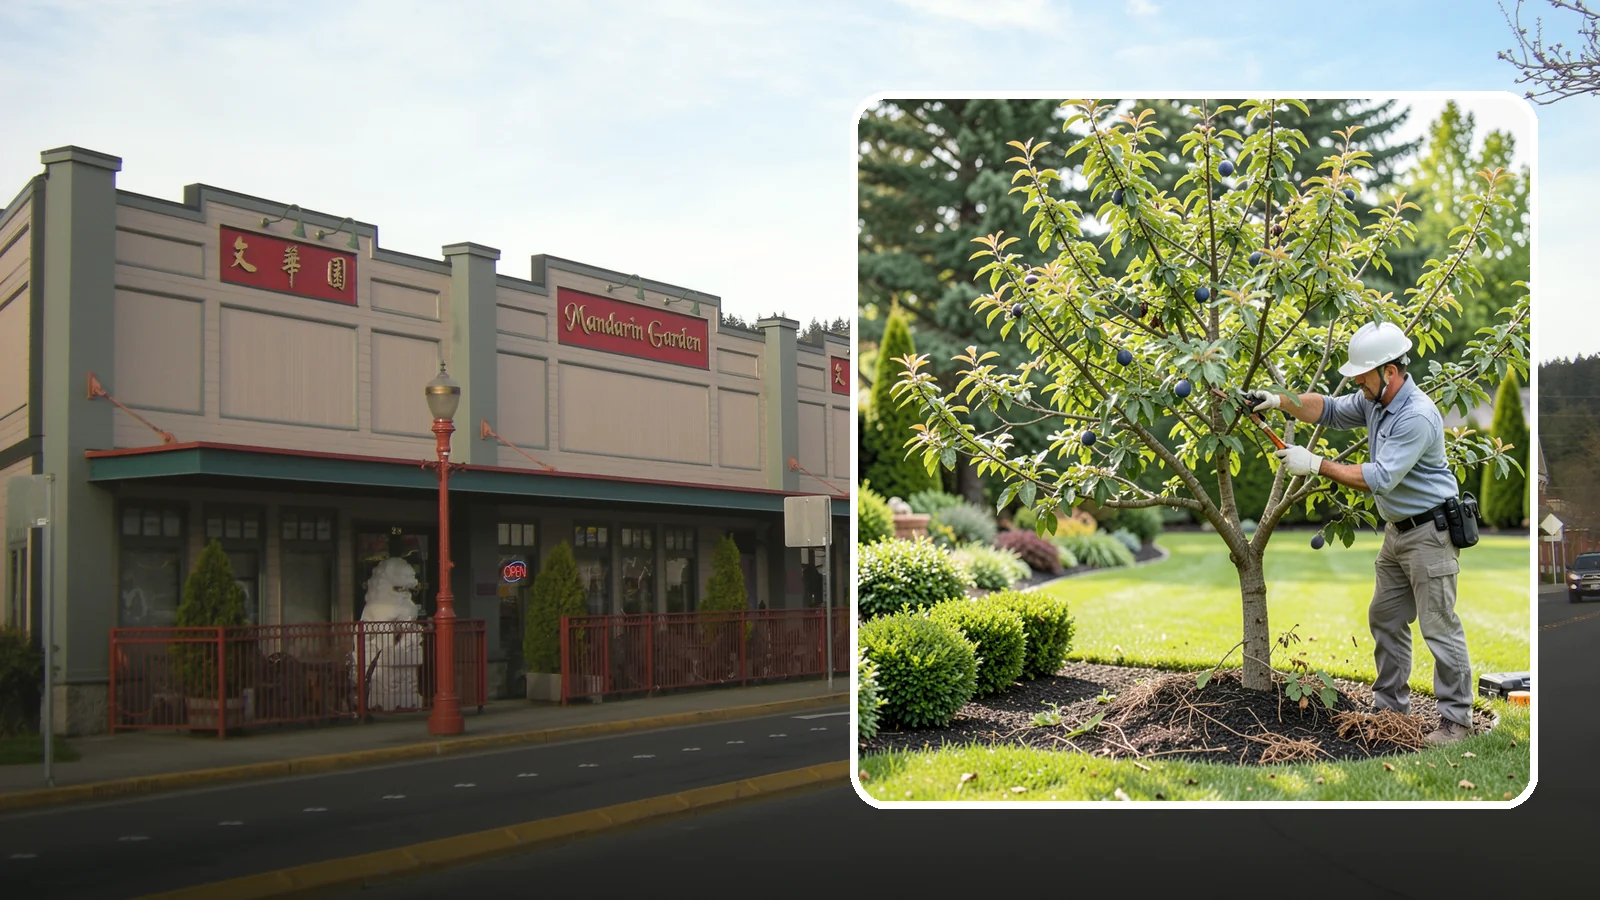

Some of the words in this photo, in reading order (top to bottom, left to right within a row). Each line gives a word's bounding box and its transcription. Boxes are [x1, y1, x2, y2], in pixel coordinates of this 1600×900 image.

[231, 235, 346, 291] 文華園
[564, 302, 643, 341] Mandarin
[648, 320, 701, 352] Garden
[503, 565, 527, 578] OPEN
